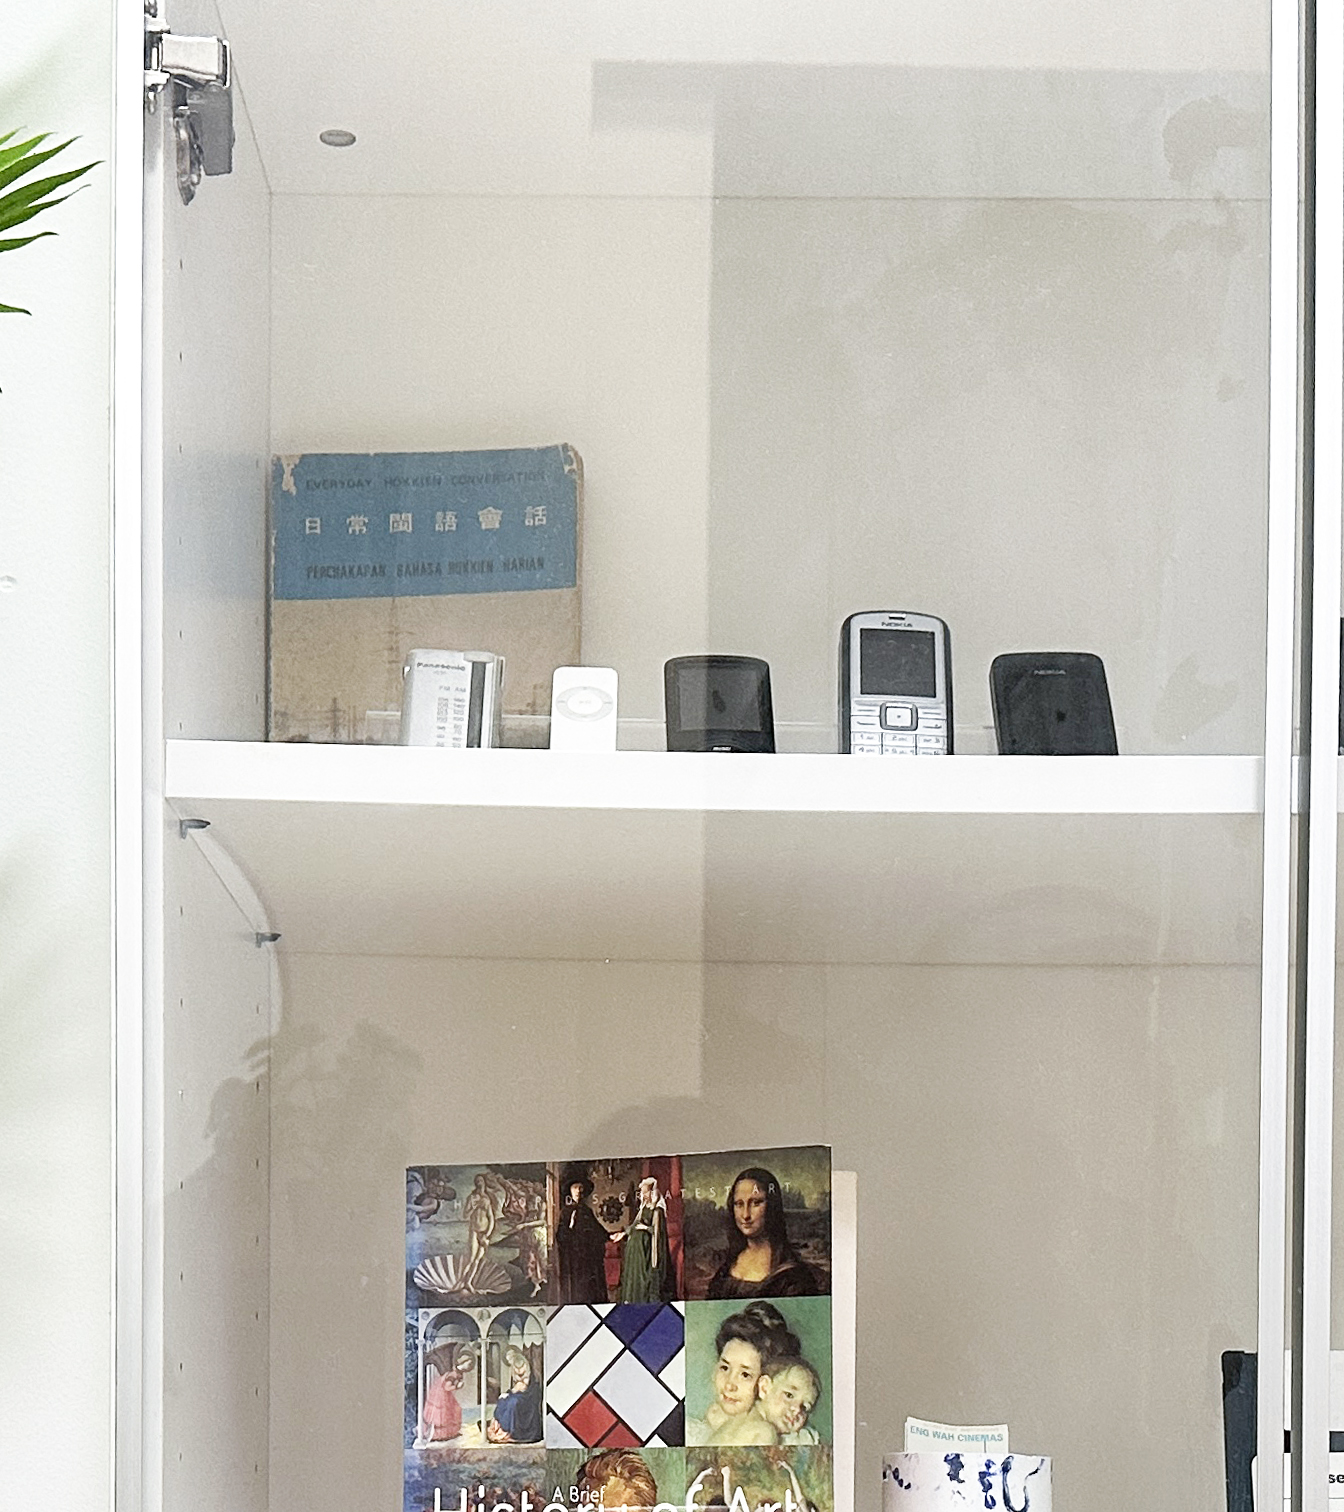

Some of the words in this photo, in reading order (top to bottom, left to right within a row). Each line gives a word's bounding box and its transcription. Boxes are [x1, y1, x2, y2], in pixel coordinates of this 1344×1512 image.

[416, 662, 466, 672] Panasonic
[752, 1181, 792, 1195] ART
[910, 1425, 930, 1437] ENG
[932, 1430, 955, 1441] WAH
[957, 1433, 1004, 1443] CINEMAS
[552, 1486, 564, 1502] A
[569, 1484, 606, 1502] Brief
